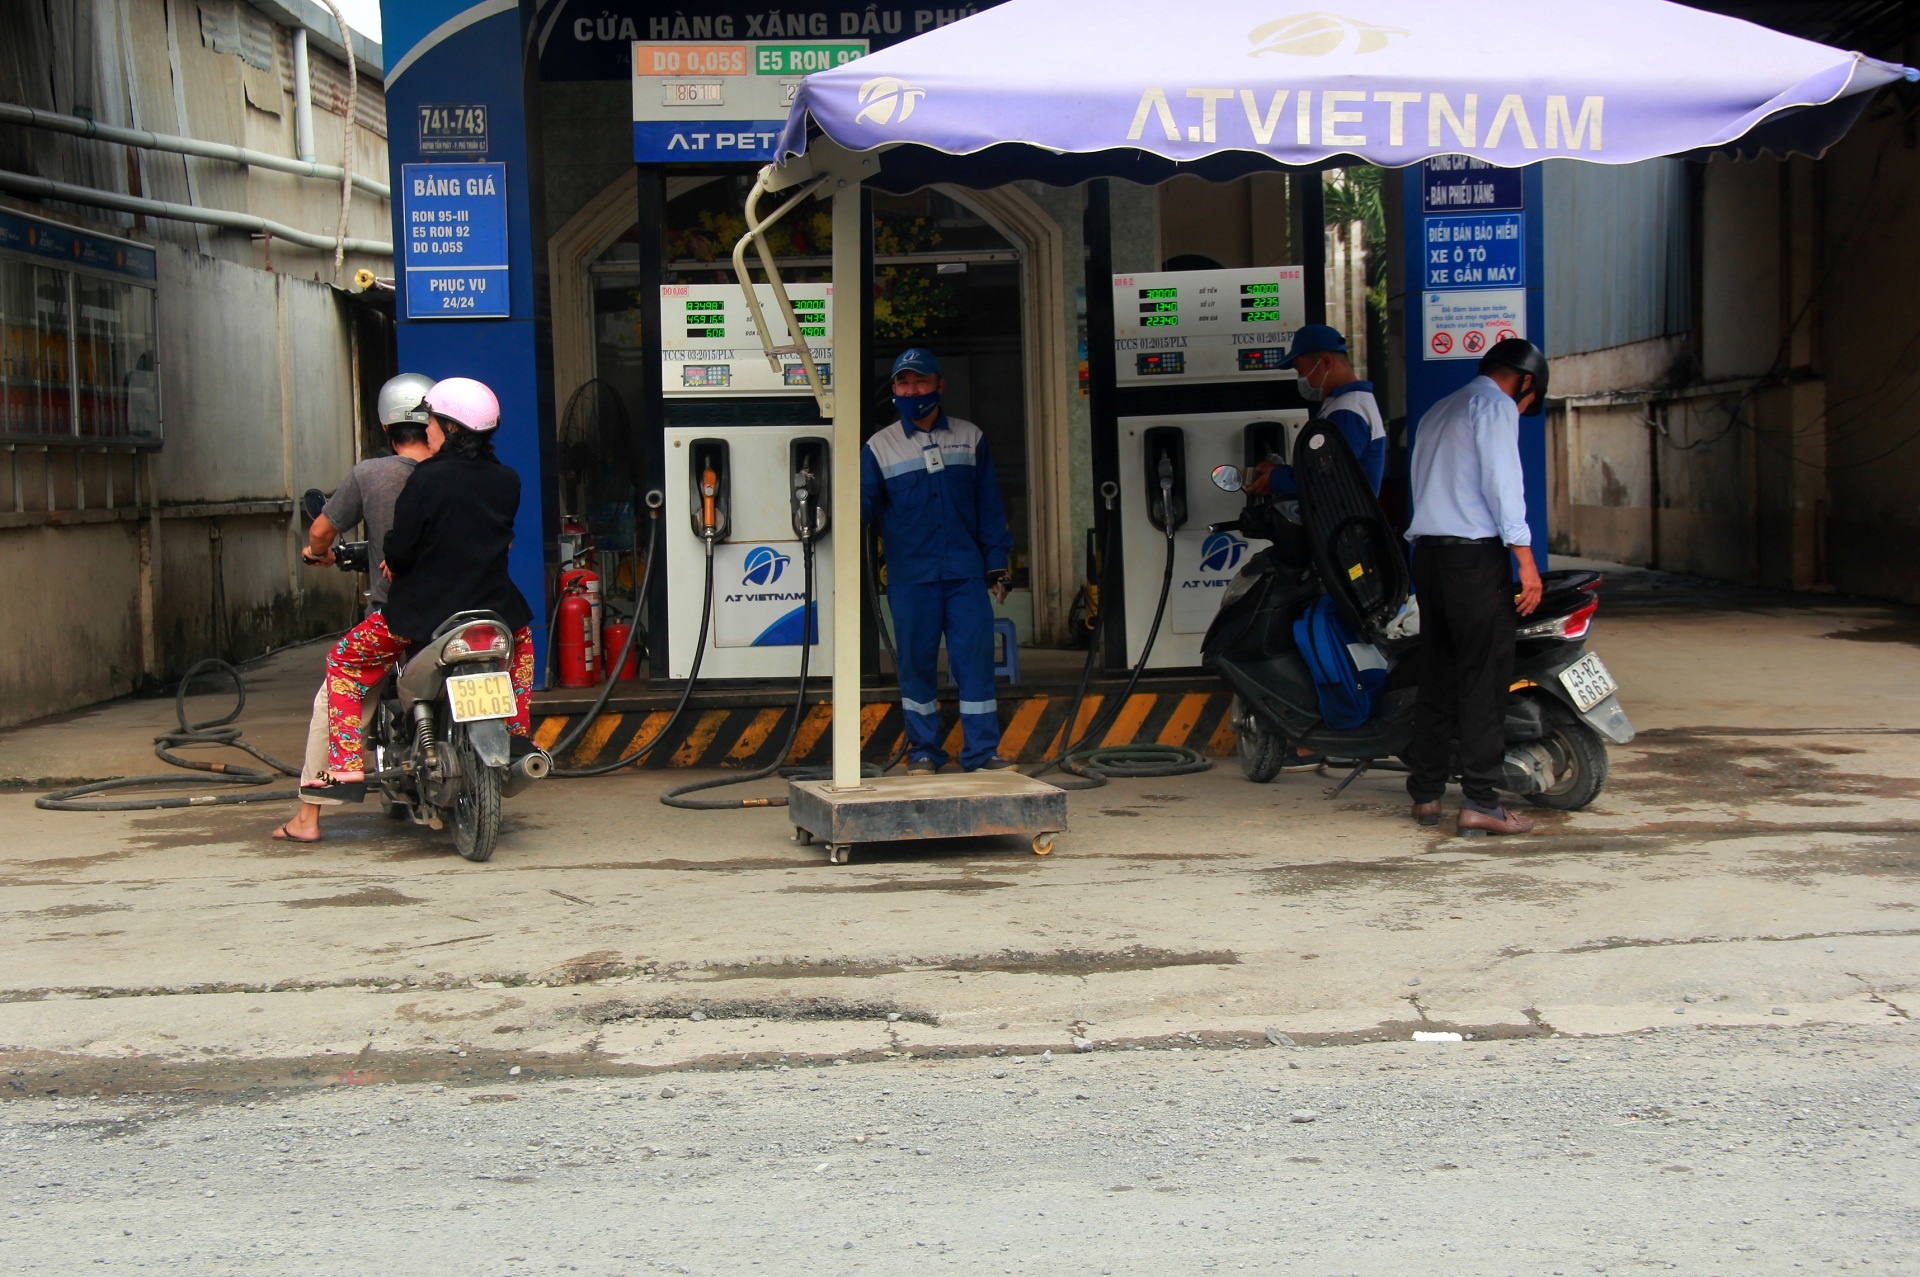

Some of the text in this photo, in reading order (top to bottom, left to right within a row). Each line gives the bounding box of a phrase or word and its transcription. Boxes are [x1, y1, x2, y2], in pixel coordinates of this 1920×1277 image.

[574, 11, 638, 41] CỬA
[650, 11, 734, 40] HÀNG
[746, 10, 828, 38] XĂNG
[840, 3, 902, 35] DẦU
[654, 52, 743, 73] DO 0,05S
[760, 51, 782, 70] E5
[790, 51, 830, 70] RON
[422, 109, 484, 134] 741-743
[716, 132, 776, 150] PET
[414, 174, 495, 196] BẢNG GIÁ
[1430, 178, 1494, 205] BÁN PHIẾU XĂNG
[412, 210, 468, 222] RON 95-III
[413, 226, 470, 238] E5 RON 92
[1429, 218, 1518, 242] ĐIỂM BÁN BẢO HIỂM
[414, 242, 463, 255] DO 0,05S
[1430, 245, 1486, 263] XE Ô TÔ
[1431, 263, 1516, 283] XE GẮN MÁY
[430, 279, 486, 294] PHỤC VỤ
[443, 297, 474, 308] 24/24
[1115, 340, 1138, 350] TCCS
[1232, 331, 1294, 344] TCCS 01:2015/P
[663, 350, 686, 361] TCCS
[1578, 676, 1610, 706] 6863
